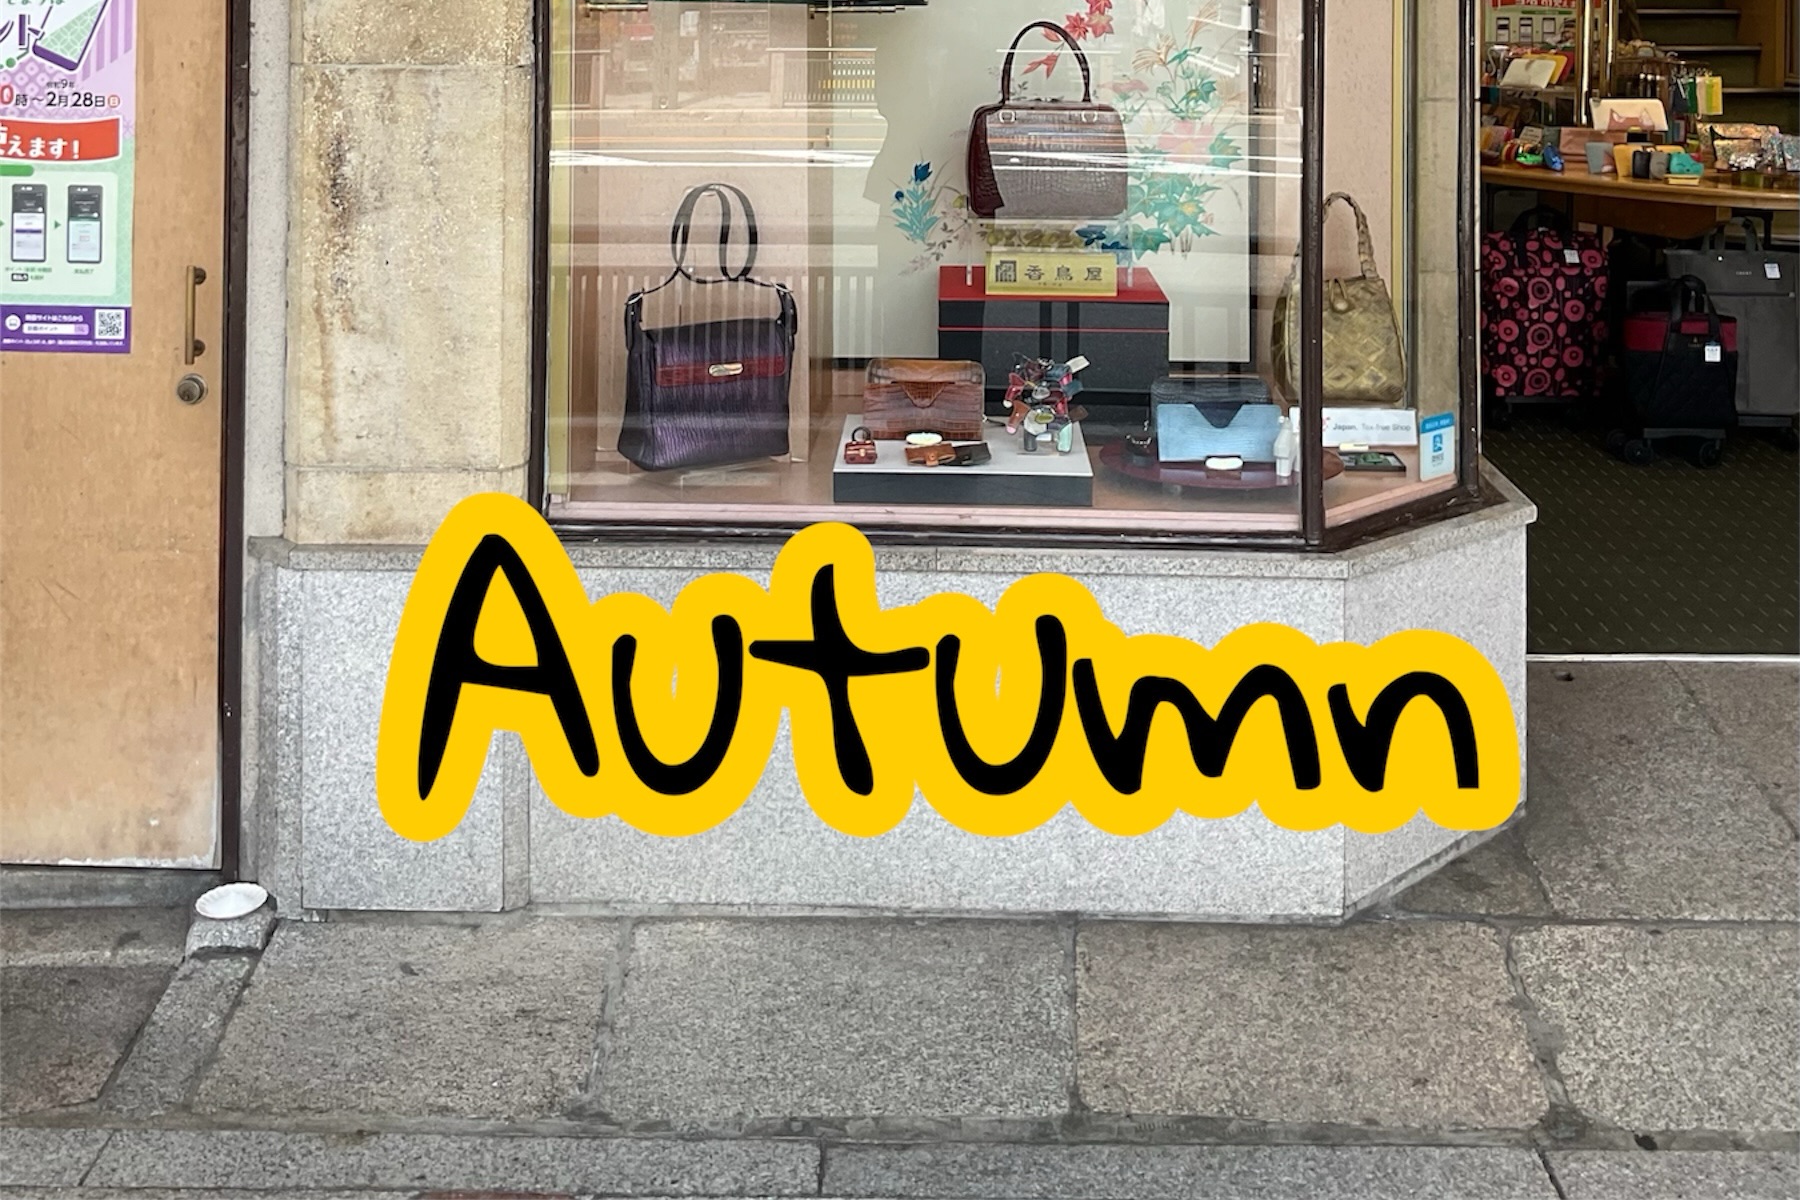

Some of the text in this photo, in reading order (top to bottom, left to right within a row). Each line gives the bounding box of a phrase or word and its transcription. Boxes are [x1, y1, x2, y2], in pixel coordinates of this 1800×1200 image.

[1024, 264, 1103, 281] 香鳥屋
[1392, 423, 1412, 432] Shop
